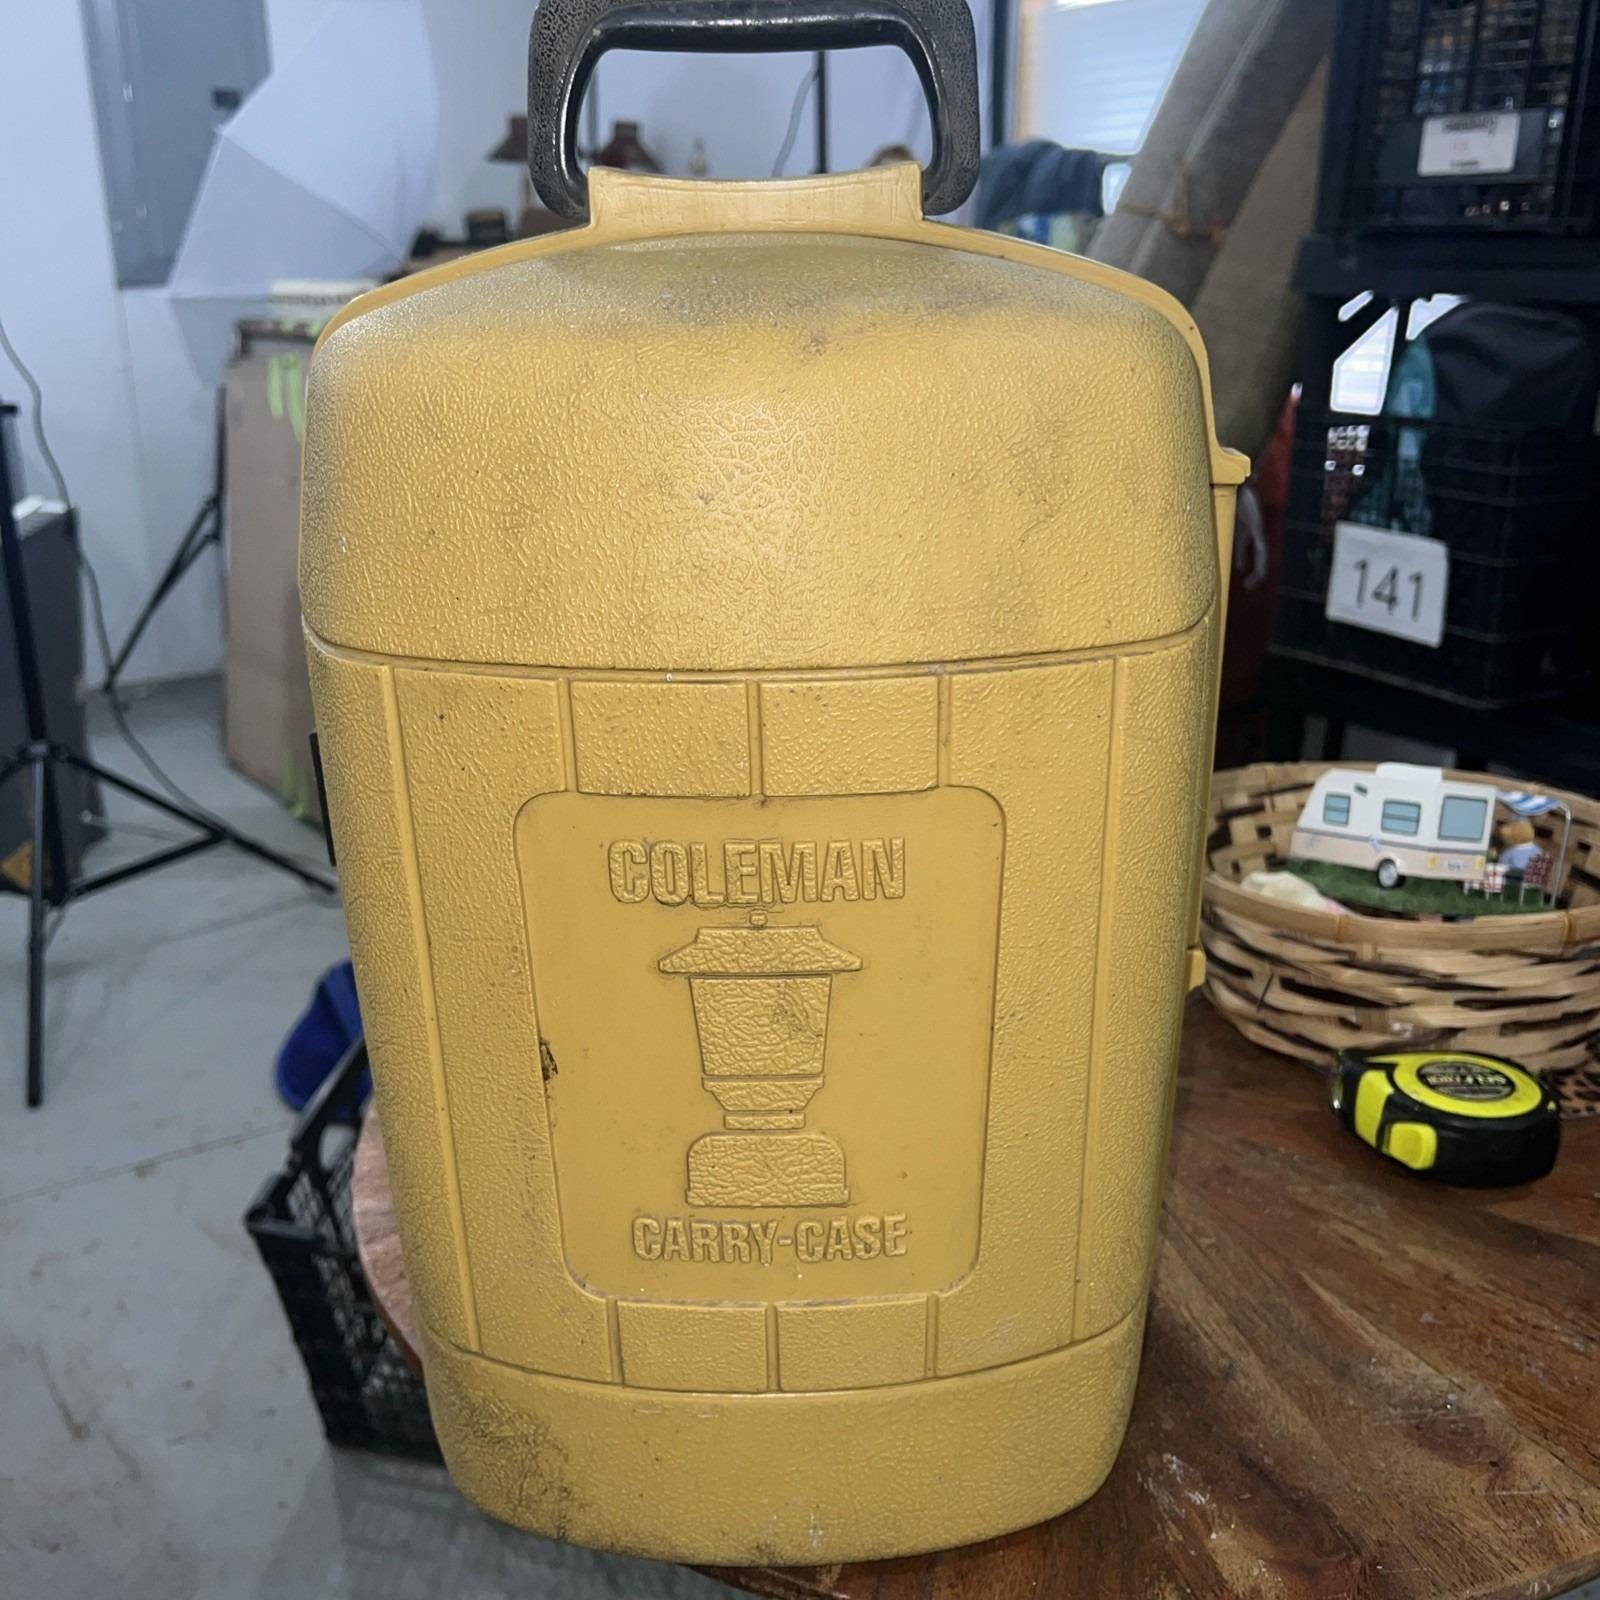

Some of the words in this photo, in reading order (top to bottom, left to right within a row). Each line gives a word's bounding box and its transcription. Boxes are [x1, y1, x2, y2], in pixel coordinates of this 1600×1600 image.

[1353, 559, 1423, 621] 141
[608, 838, 906, 906] COLEMAN
[632, 1213, 909, 1267] CARRY-CASE
